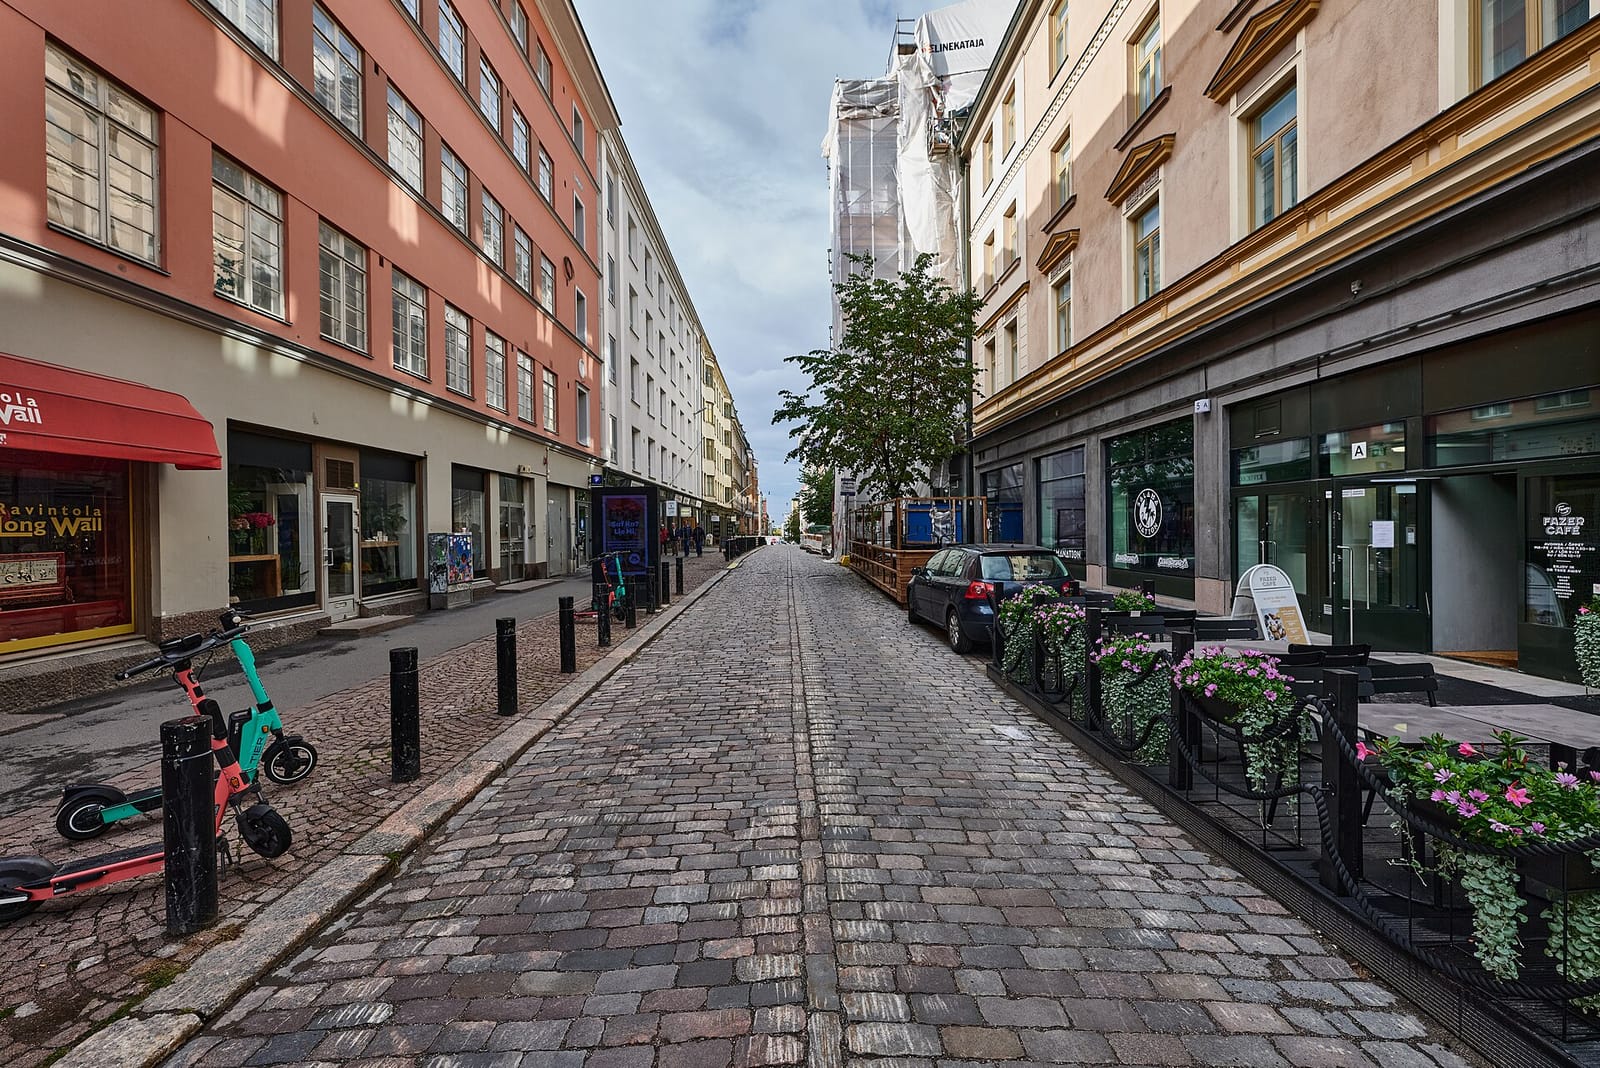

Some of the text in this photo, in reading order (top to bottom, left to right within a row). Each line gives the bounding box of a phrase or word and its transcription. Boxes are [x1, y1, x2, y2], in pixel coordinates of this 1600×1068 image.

[930, 39, 984, 53] ELINEKATAJA
[1354, 445, 1364, 457] A
[0, 503, 102, 516] Ravintola
[0, 515, 102, 537] Long Wall
[1543, 517, 1585, 526] FAZER
[250, 737, 264, 764] TIER
